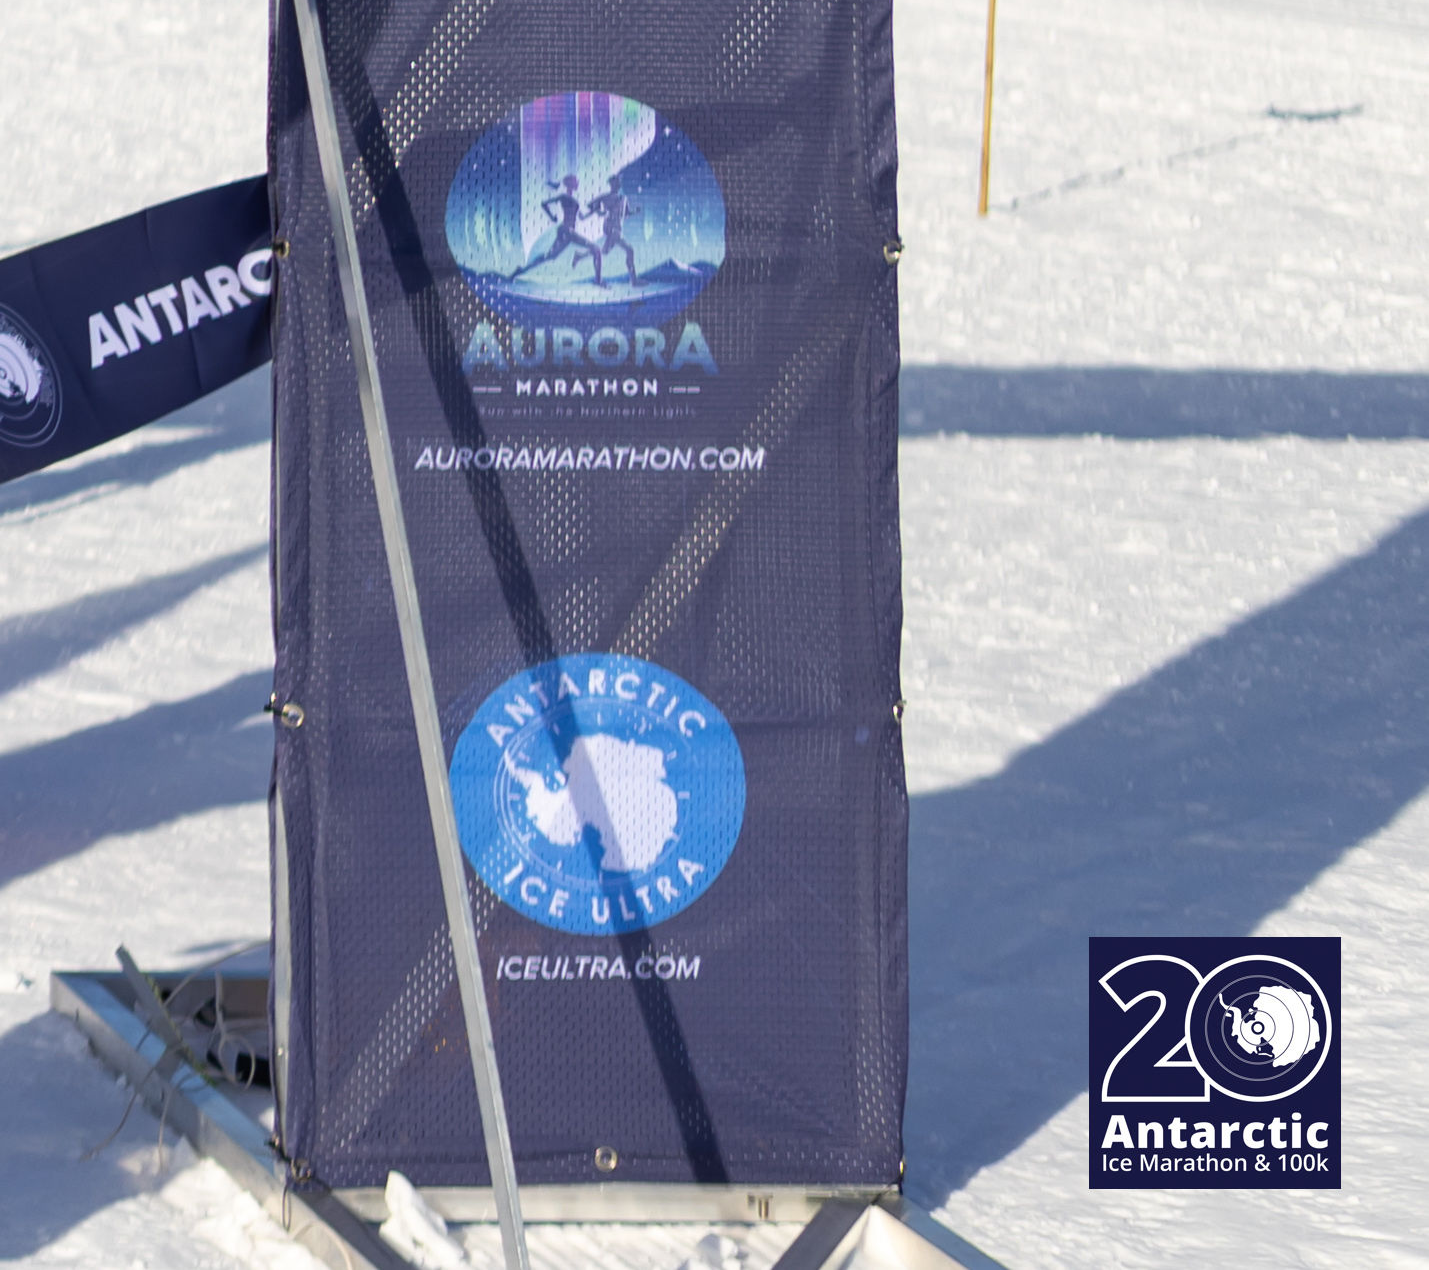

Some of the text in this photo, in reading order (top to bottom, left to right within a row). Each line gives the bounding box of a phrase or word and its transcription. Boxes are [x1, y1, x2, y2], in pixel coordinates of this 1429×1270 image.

[461, 321, 719, 376] AURORA
[516, 378, 659, 397] MARATHON
[414, 446, 765, 471] AURORAMARATHON.COM
[487, 668, 706, 747] ANTARCTIC
[503, 858, 705, 924] ICE ULTRA
[496, 956, 701, 981] ICEULTRA.COM
